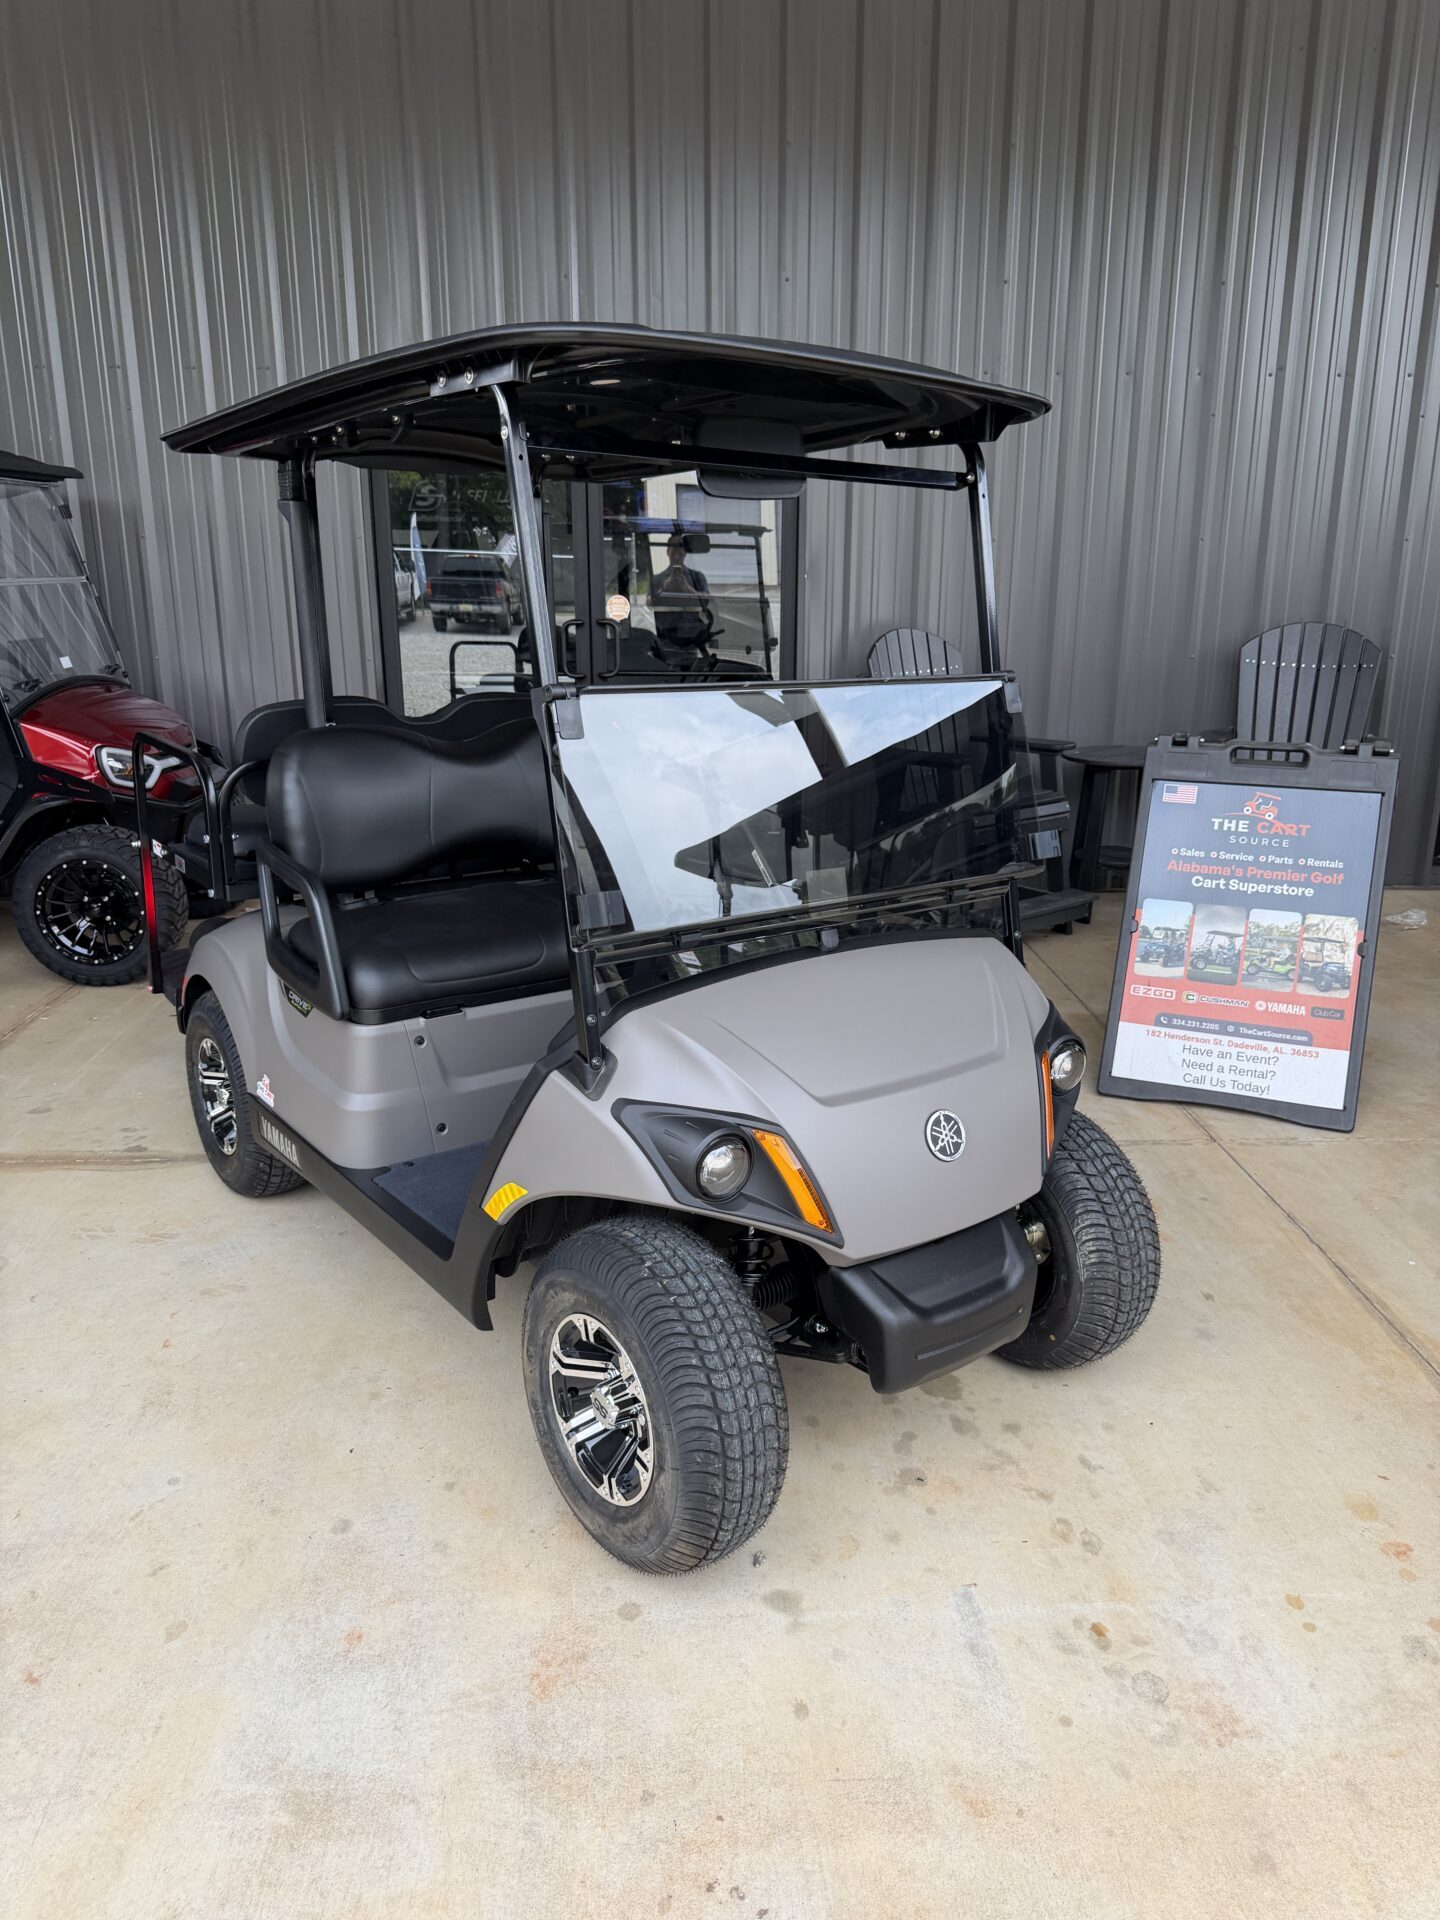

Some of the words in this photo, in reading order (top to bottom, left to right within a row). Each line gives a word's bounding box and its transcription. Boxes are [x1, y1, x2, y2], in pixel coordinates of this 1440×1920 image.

[1211, 818, 1250, 832] THE
[1256, 821, 1311, 837] CART
[1229, 835, 1290, 848] SOURCE
[1180, 848, 1205, 858] Sales
[1218, 851, 1254, 862] Service
[1267, 855, 1294, 865] Parts
[1307, 858, 1344, 869] Rentals
[1167, 859, 1243, 877] Alabama's
[1246, 866, 1308, 882] Premier
[1310, 871, 1345, 885] Golf
[1191, 875, 1226, 890] Cart
[1228, 879, 1315, 897] Superstore
[1200, 996, 1249, 1007] CUSHMAN
[1267, 1001, 1306, 1016] YAMAHA
[1146, 1029, 1162, 1038] 182
[1164, 1032, 1211, 1044] Henderson
[1213, 1038, 1225, 1047] St.
[1227, 1039, 1270, 1054] Dadeville,
[1290, 1048, 1320, 1059] 36853
[1239, 1027, 1308, 1041] TheCartSource.com
[1182, 1044, 1214, 1058] Have
[1217, 1049, 1232, 1060] an
[1236, 1051, 1280, 1067] Event?
[1181, 1058, 1214, 1072] Need
[1217, 1065, 1225, 1074] a
[1228, 1065, 1277, 1081] Rental?
[1182, 1073, 1206, 1085] Call
[1210, 1077, 1226, 1088] Us
[1230, 1079, 1271, 1097] Today!
[261, 1115, 300, 1168] YAMAHA
